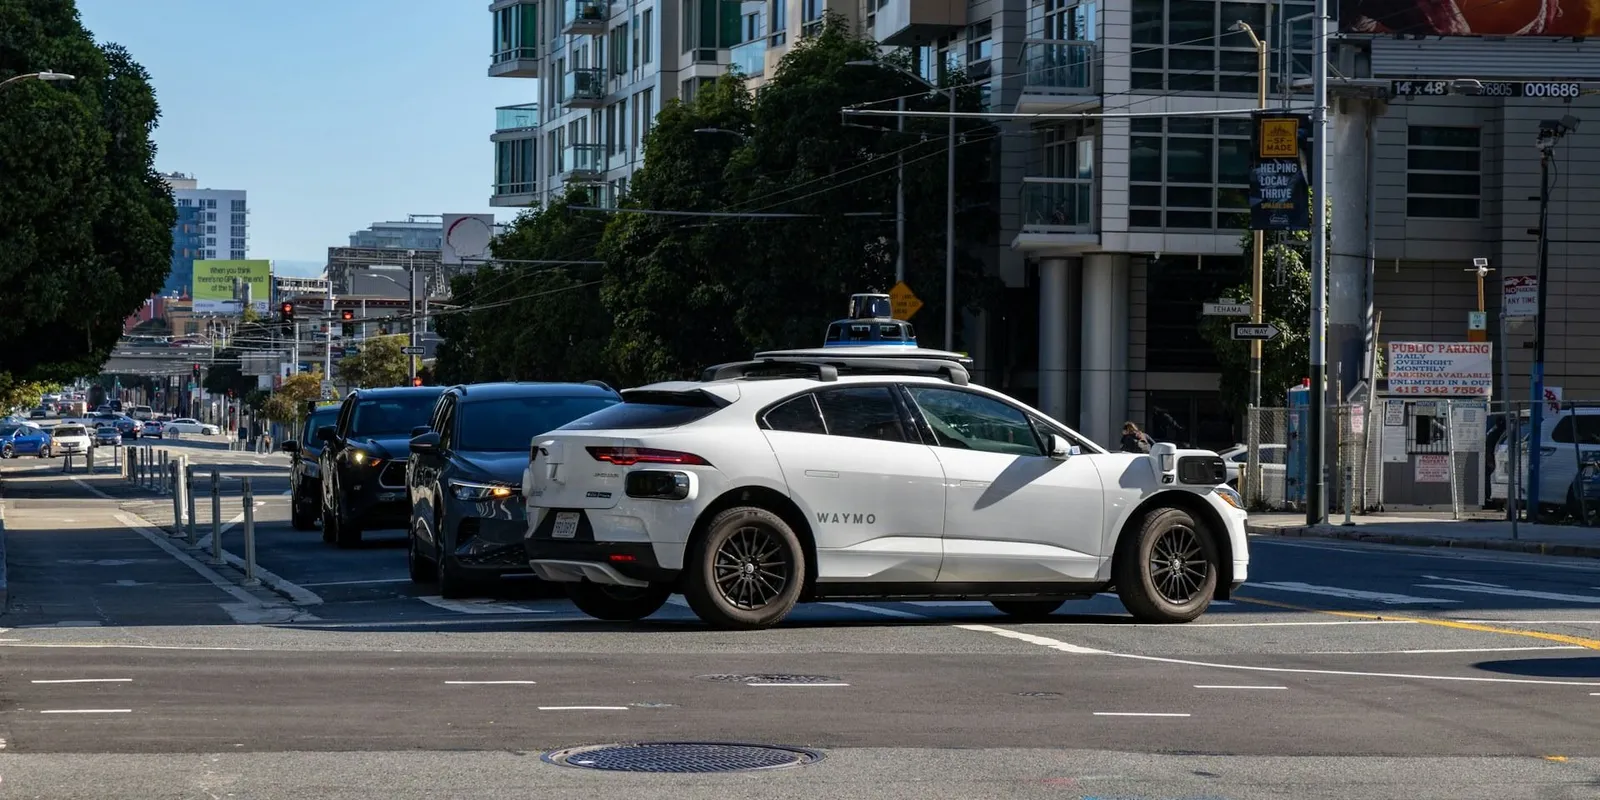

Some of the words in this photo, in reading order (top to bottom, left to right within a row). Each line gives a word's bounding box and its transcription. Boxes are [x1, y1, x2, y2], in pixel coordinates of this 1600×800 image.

[1414, 86, 1422, 94] x
[1525, 83, 1579, 97] 001686
[1260, 163, 1298, 173] HELPING
[1260, 175, 1288, 186] LOCAL
[1260, 188, 1292, 199] THRIVE
[1522, 296, 1536, 304] TIME
[1391, 343, 1434, 353] PUBLIC
[1438, 344, 1489, 354] PARKING
[1424, 386, 1448, 394] 342
[1452, 386, 1485, 394] 7554
[817, 512, 876, 524] WAYMO
